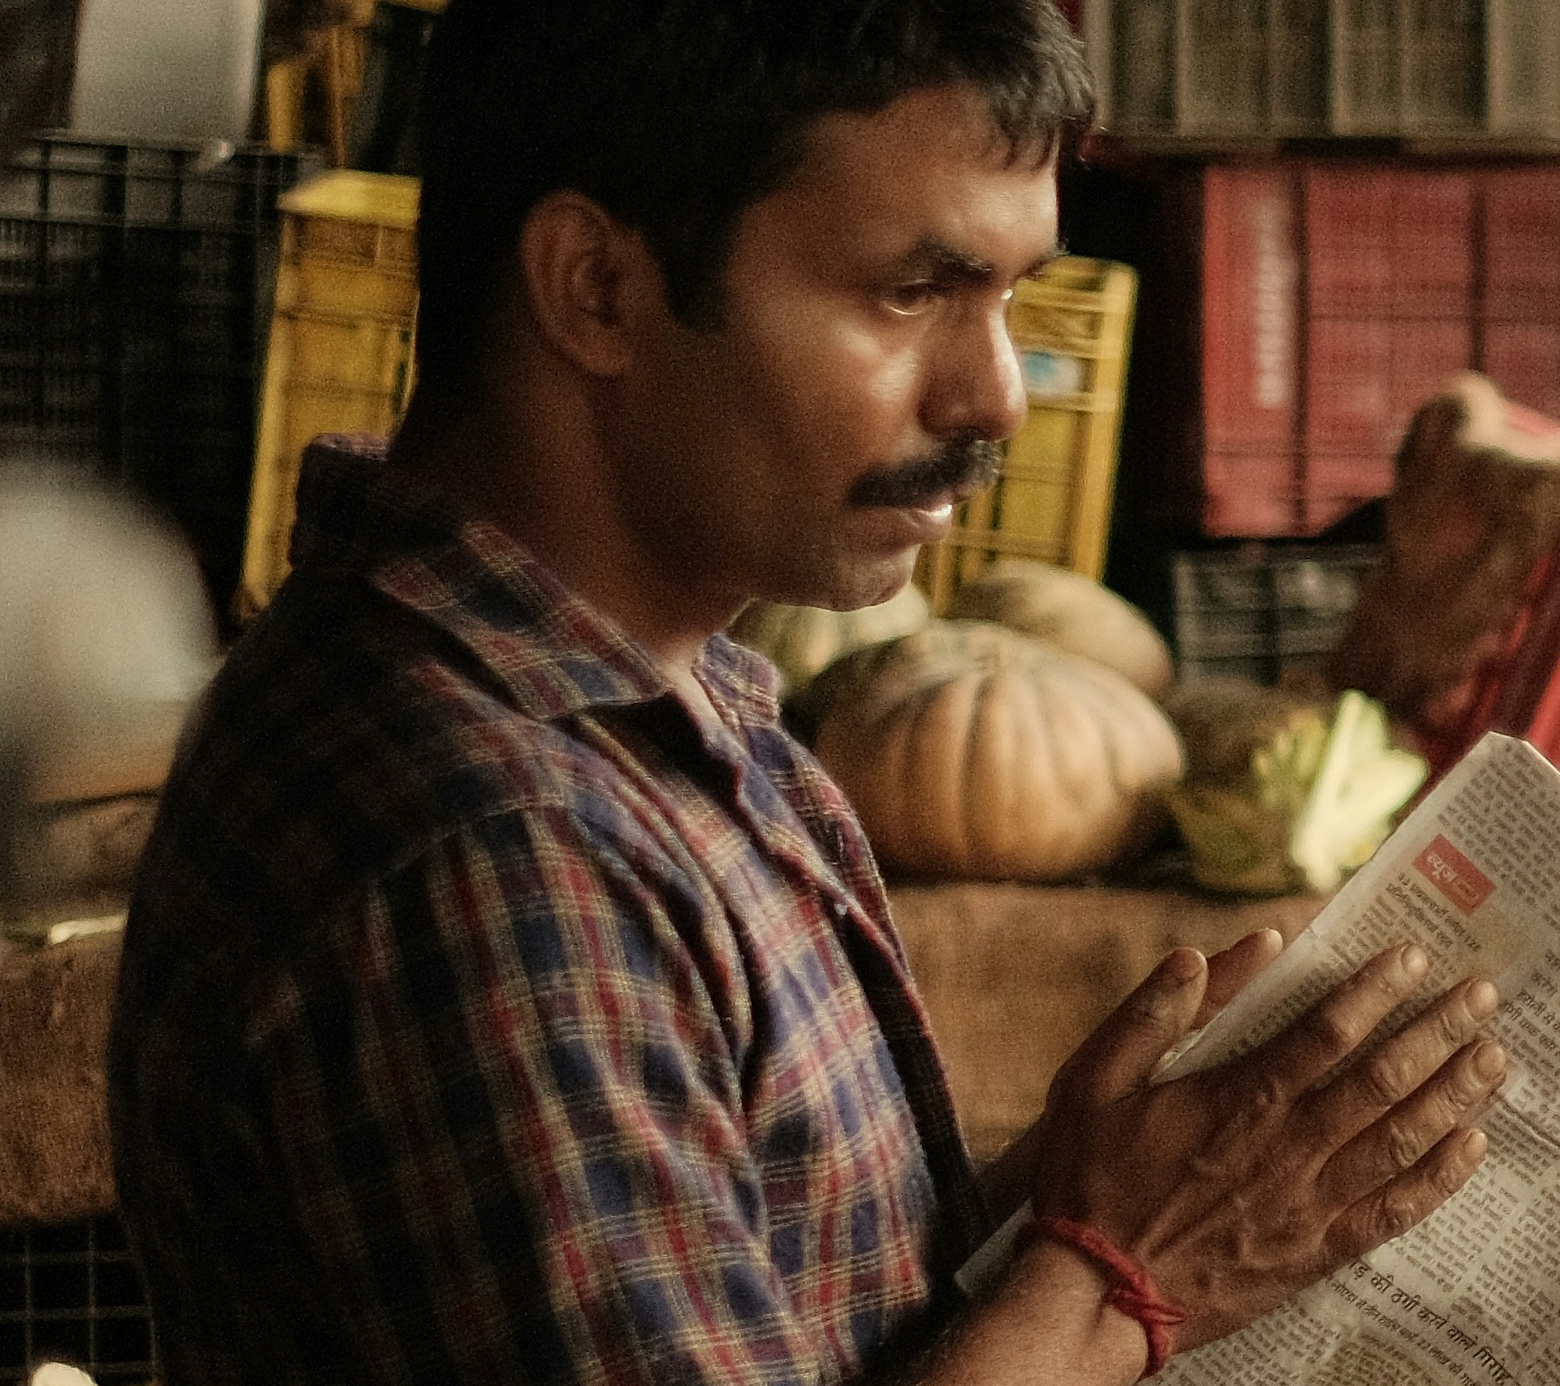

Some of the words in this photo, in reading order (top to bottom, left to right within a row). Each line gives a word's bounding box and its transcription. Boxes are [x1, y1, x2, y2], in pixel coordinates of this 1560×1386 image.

[1427, 853, 1458, 883] न्यूज
[1370, 1271, 1395, 1294] की
[1390, 1287, 1422, 1313] ठगी
[1417, 1305, 1451, 1330] करने
[1446, 1324, 1479, 1351] वाले
[1472, 1345, 1514, 1386] गिरोह
[1448, 1362, 1464, 1376] की
